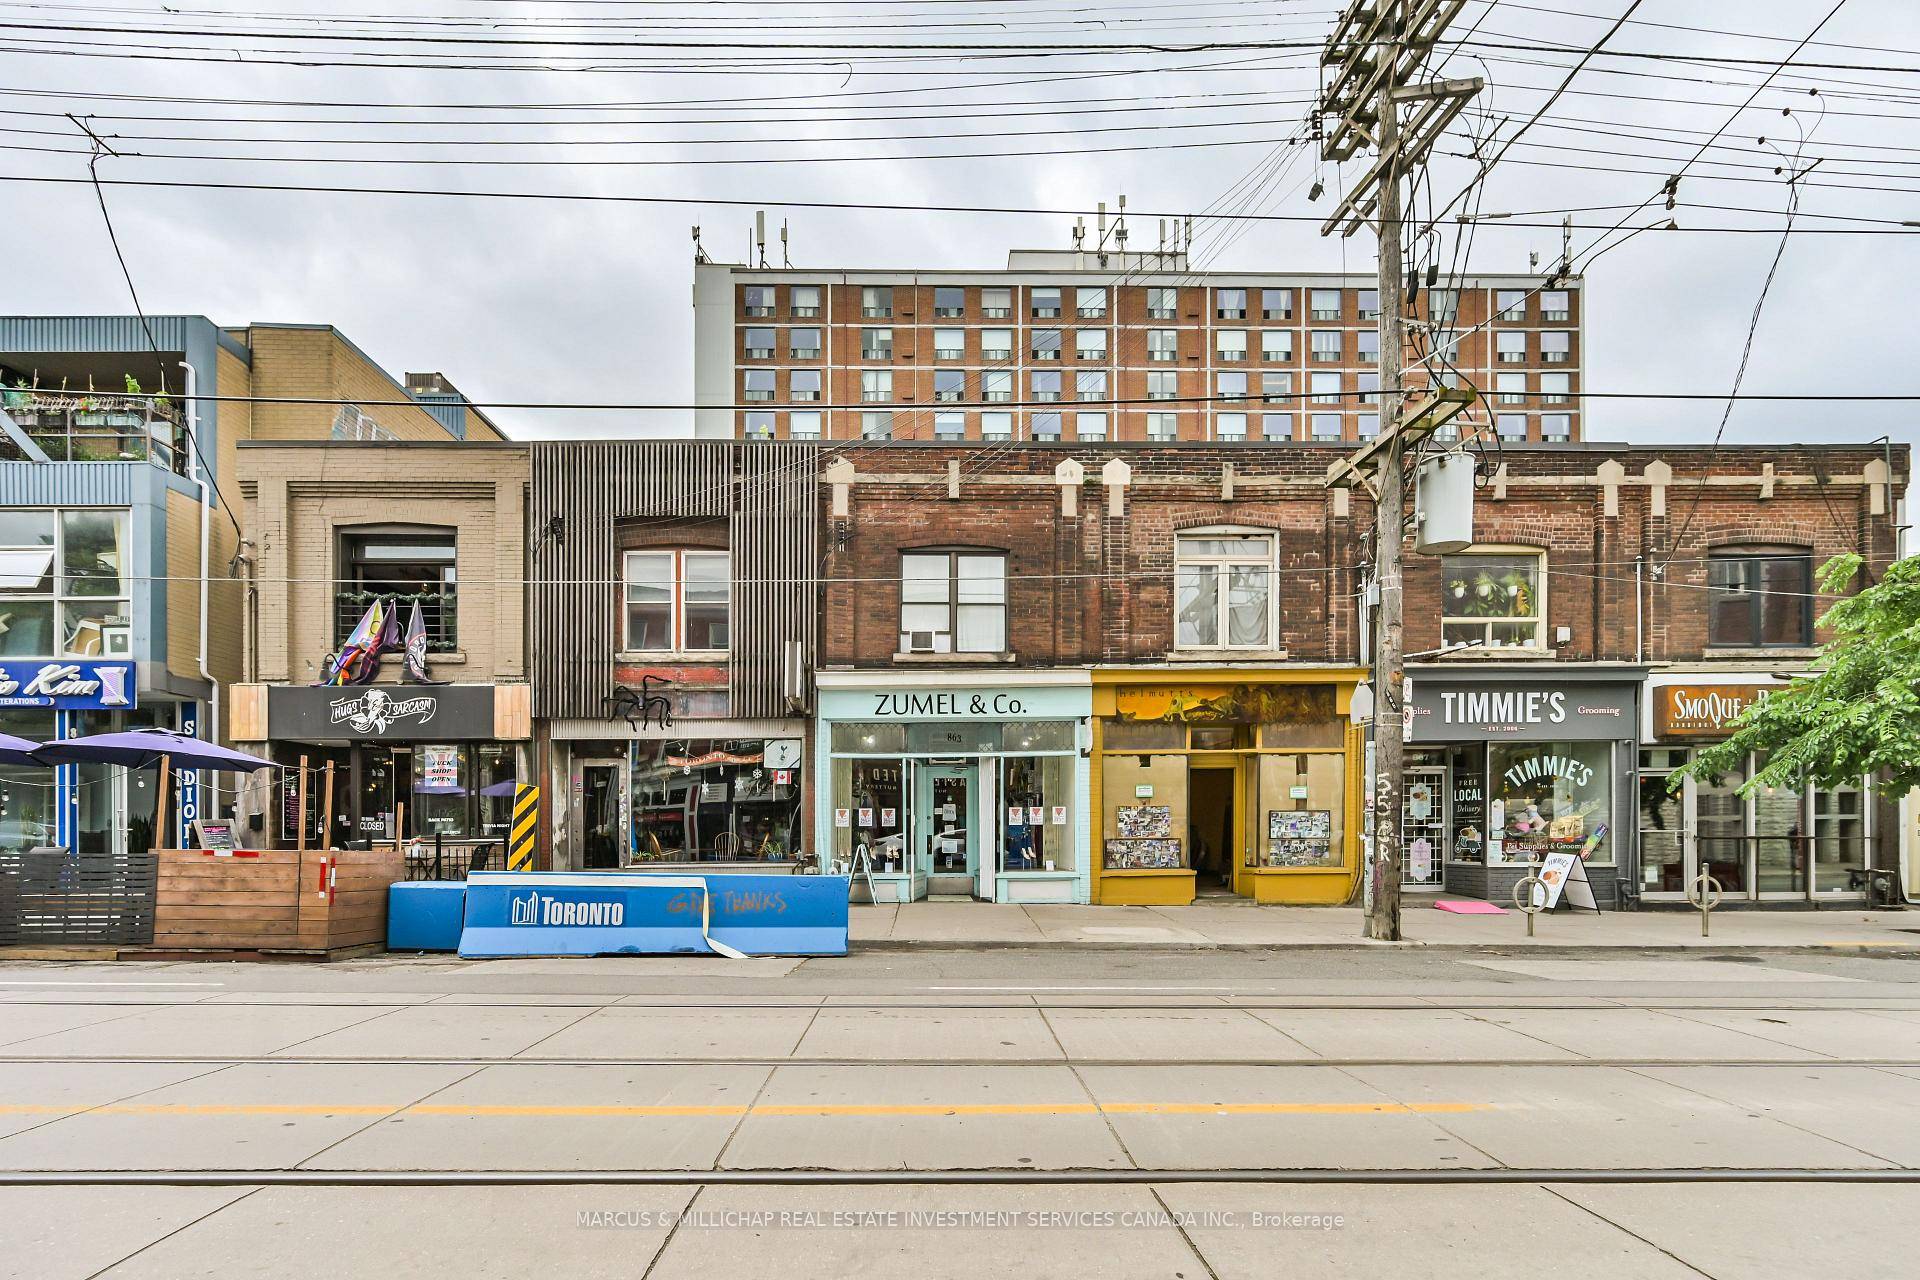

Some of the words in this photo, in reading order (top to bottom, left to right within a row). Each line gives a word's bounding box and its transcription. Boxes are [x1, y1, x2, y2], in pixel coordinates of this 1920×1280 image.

[23, 664, 100, 695] Kim
[0, 697, 40, 705] TERATIONS
[875, 694, 961, 715] ZUMEL
[969, 694, 988, 714] &
[993, 694, 1027, 714] Co.
[335, 702, 357, 719] HUGS
[393, 699, 431, 715] SARCASM
[1412, 705, 1431, 718] plies
[1441, 692, 1566, 724] TIMMIE'S
[1577, 706, 1620, 717] Grooming
[947, 733, 962, 742] 863
[1504, 755, 1593, 787] TIMMIE'S
[1454, 788, 1482, 801] LOCAL
[1457, 804, 1480, 815] Delivery
[359, 821, 384, 831] CLOSED
[1519, 842, 1550, 852] Supplies
[1556, 841, 1585, 849] Groomi
[541, 896, 623, 926] TORONTO
